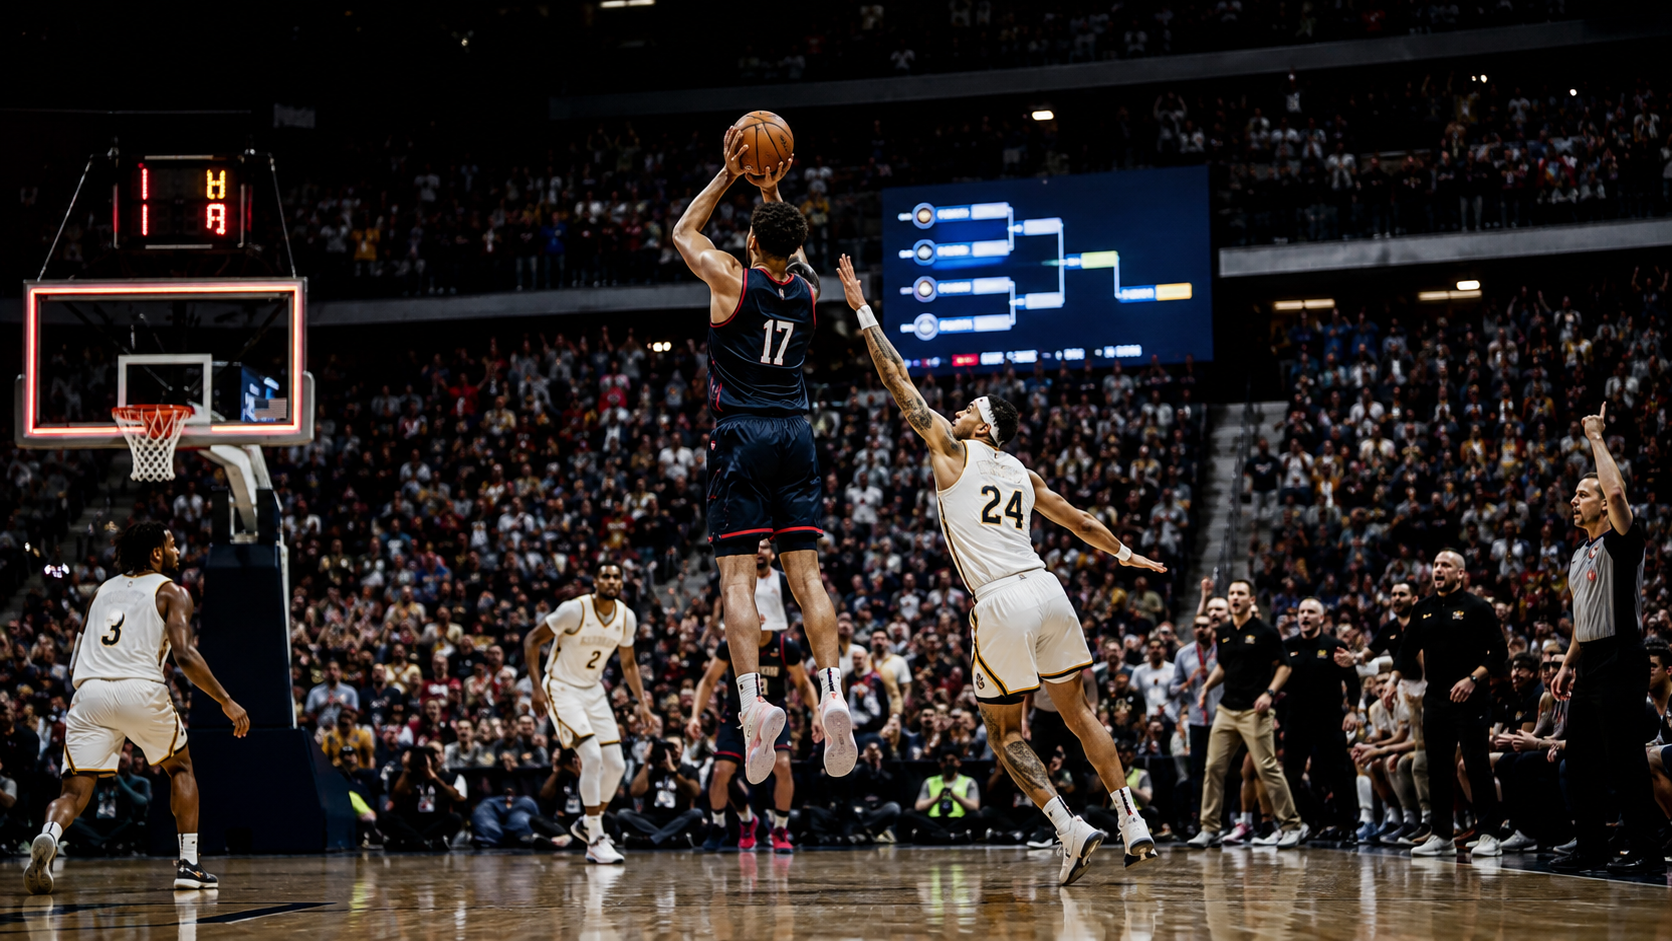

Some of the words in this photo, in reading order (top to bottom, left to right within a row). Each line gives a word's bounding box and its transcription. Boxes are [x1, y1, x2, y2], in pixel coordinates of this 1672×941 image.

[760, 319, 795, 366] 17
[981, 485, 1024, 530] 24
[101, 612, 127, 648] 3
[586, 650, 602, 670] 2
